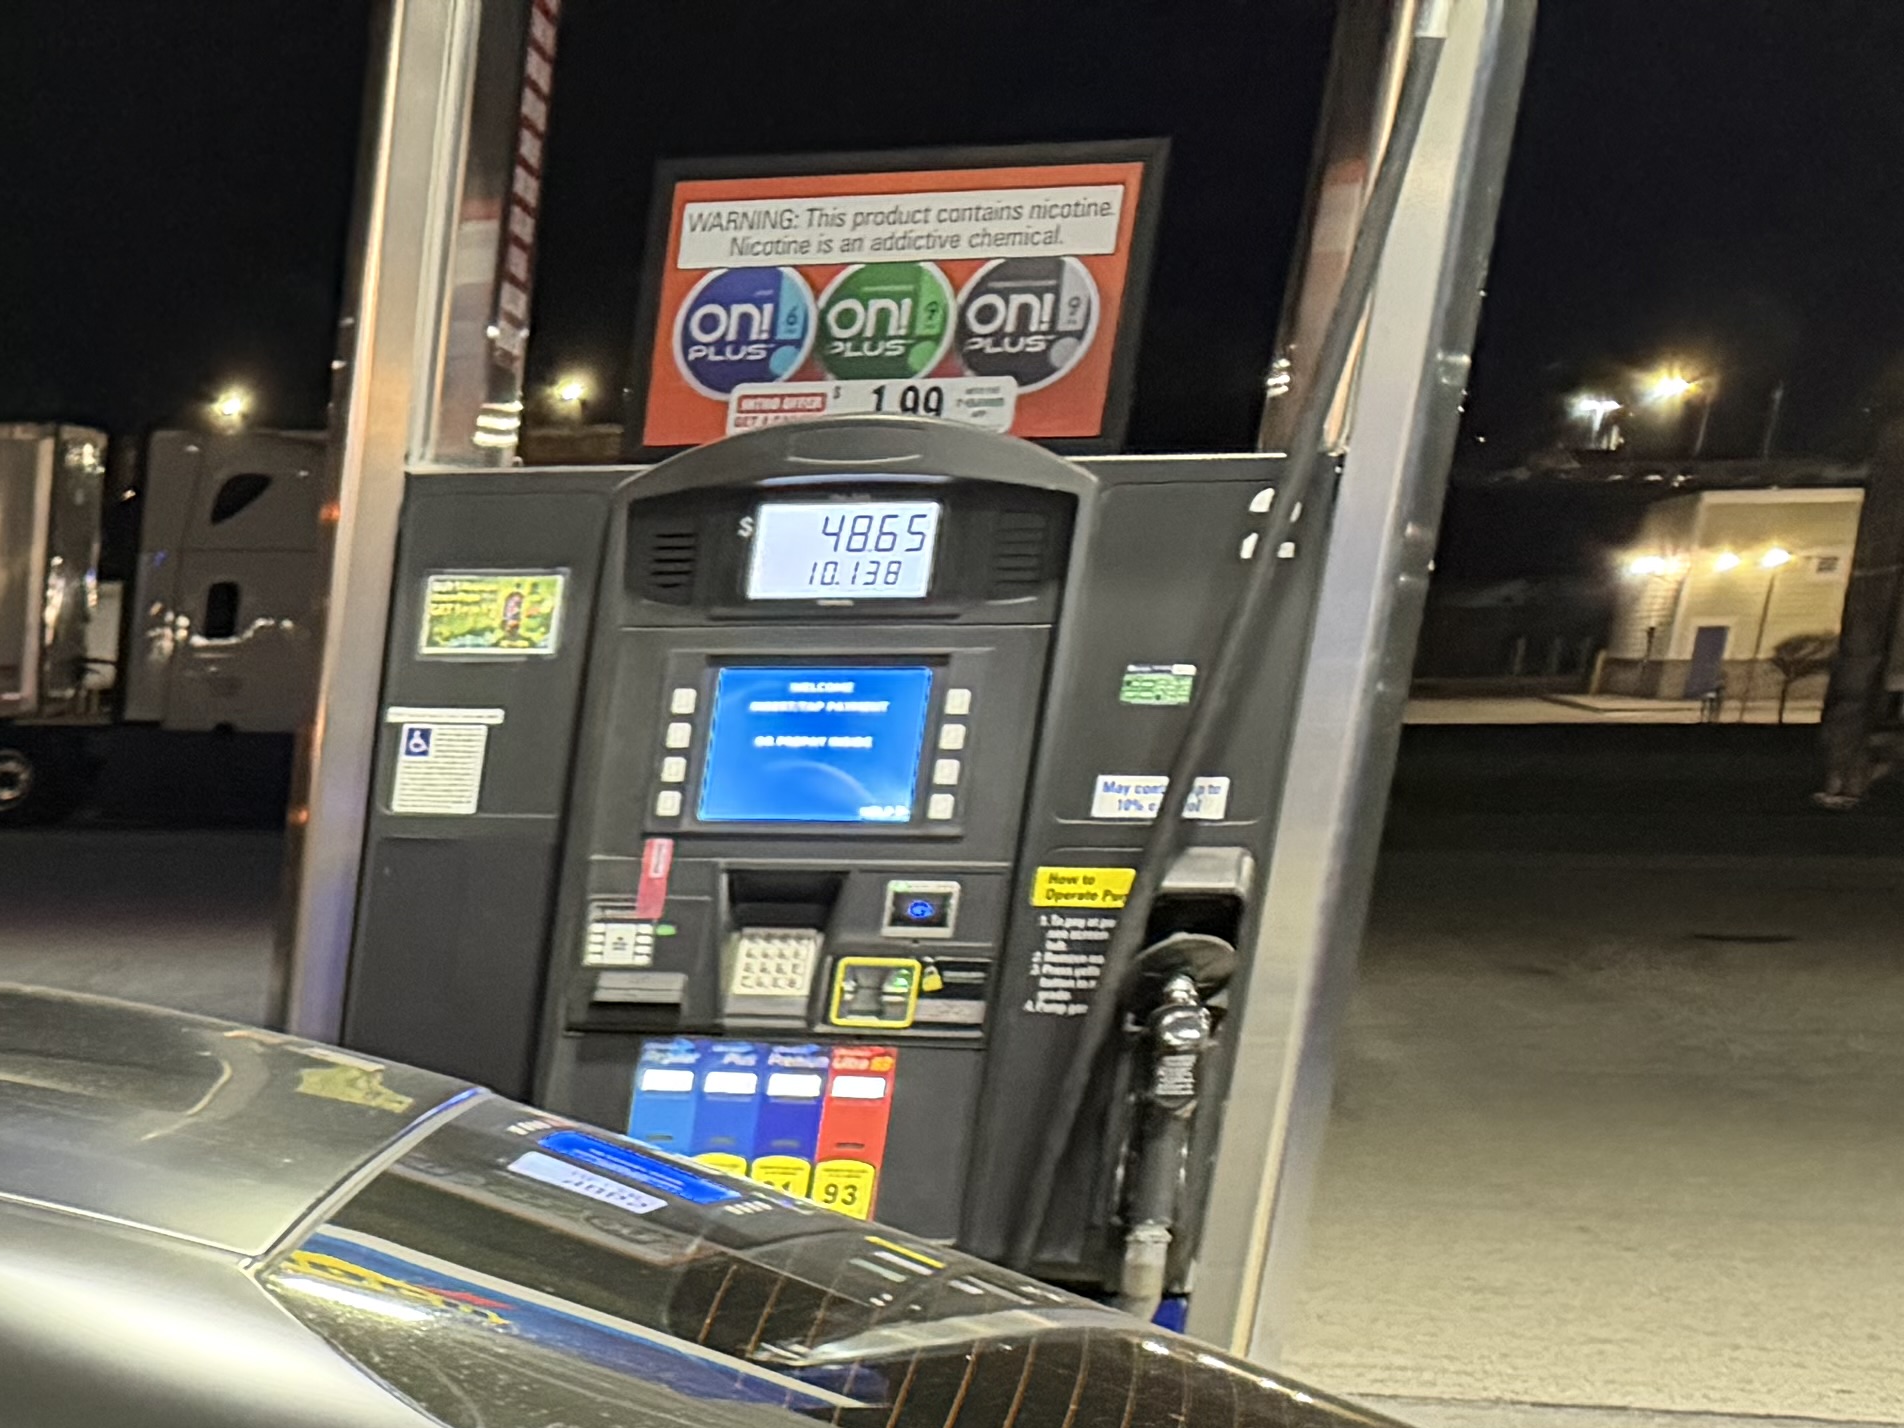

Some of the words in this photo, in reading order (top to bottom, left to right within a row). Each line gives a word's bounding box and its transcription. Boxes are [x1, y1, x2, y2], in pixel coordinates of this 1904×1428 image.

[688, 209, 799, 233] WARNING:
[806, 206, 846, 228] This
[852, 202, 931, 228] product
[938, 200, 1023, 223] contains
[1029, 197, 1116, 220] nicotine.
[729, 233, 810, 257] Nicotine
[817, 234, 834, 254] is
[840, 237, 863, 253] an
[870, 227, 961, 251] addictive
[967, 224, 1065, 248] chemical.
[688, 345, 768, 362] PLUS
[737, 516, 754, 537] $
[808, 561, 902, 586] 10.138
[1103, 781, 1131, 796] May
[1048, 873, 1079, 885] How
[1083, 874, 1096, 885] to
[1045, 888, 1099, 903] Operate
[823, 1183, 859, 1207] 93
